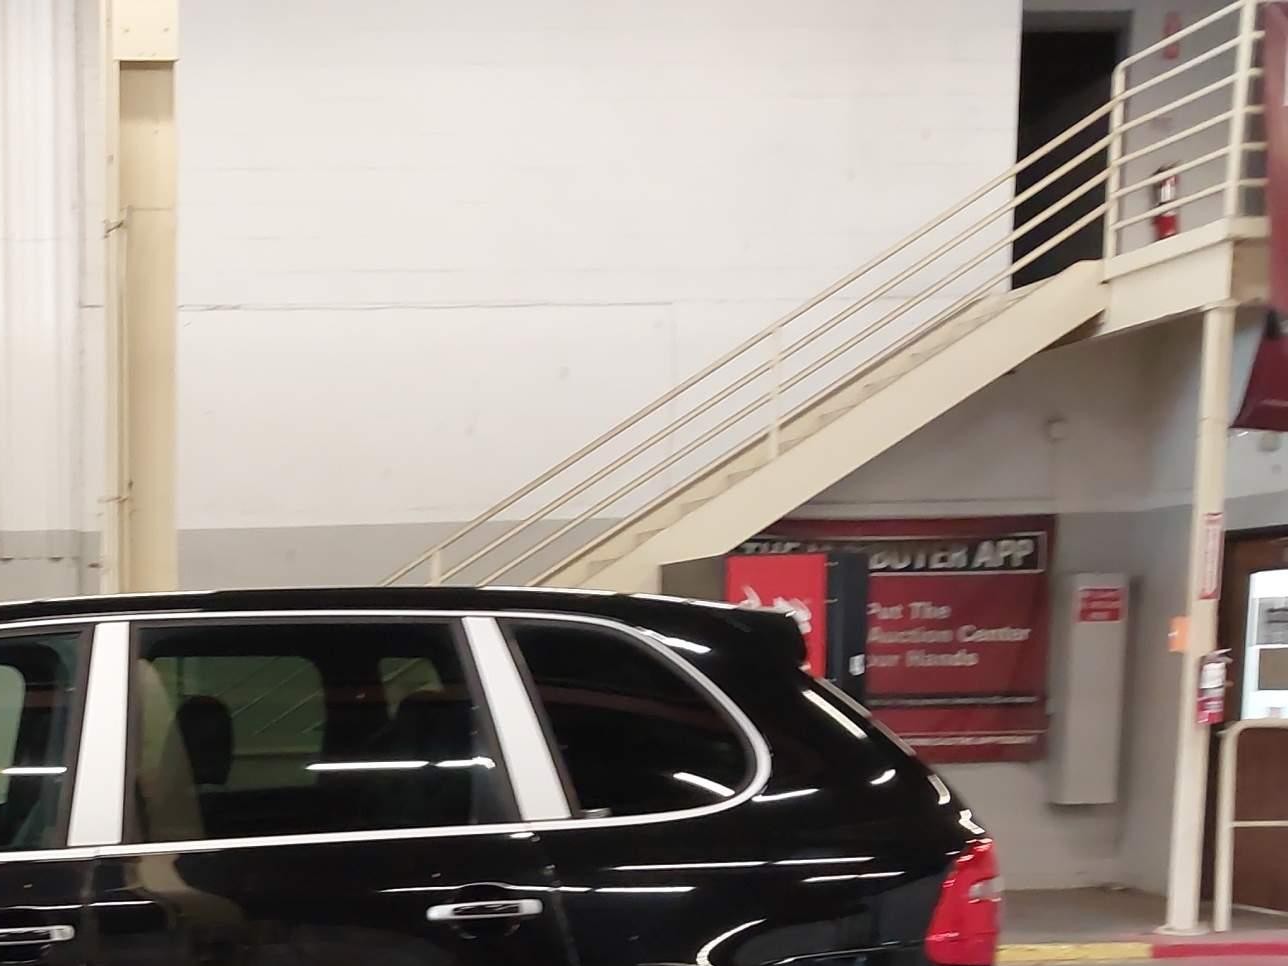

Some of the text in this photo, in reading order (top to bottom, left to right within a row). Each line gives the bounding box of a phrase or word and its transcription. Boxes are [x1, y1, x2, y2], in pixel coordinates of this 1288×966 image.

[971, 538, 1035, 569] APP
[908, 601, 952, 620] The
[956, 624, 1033, 643] Center
[905, 648, 979, 668] Hands
